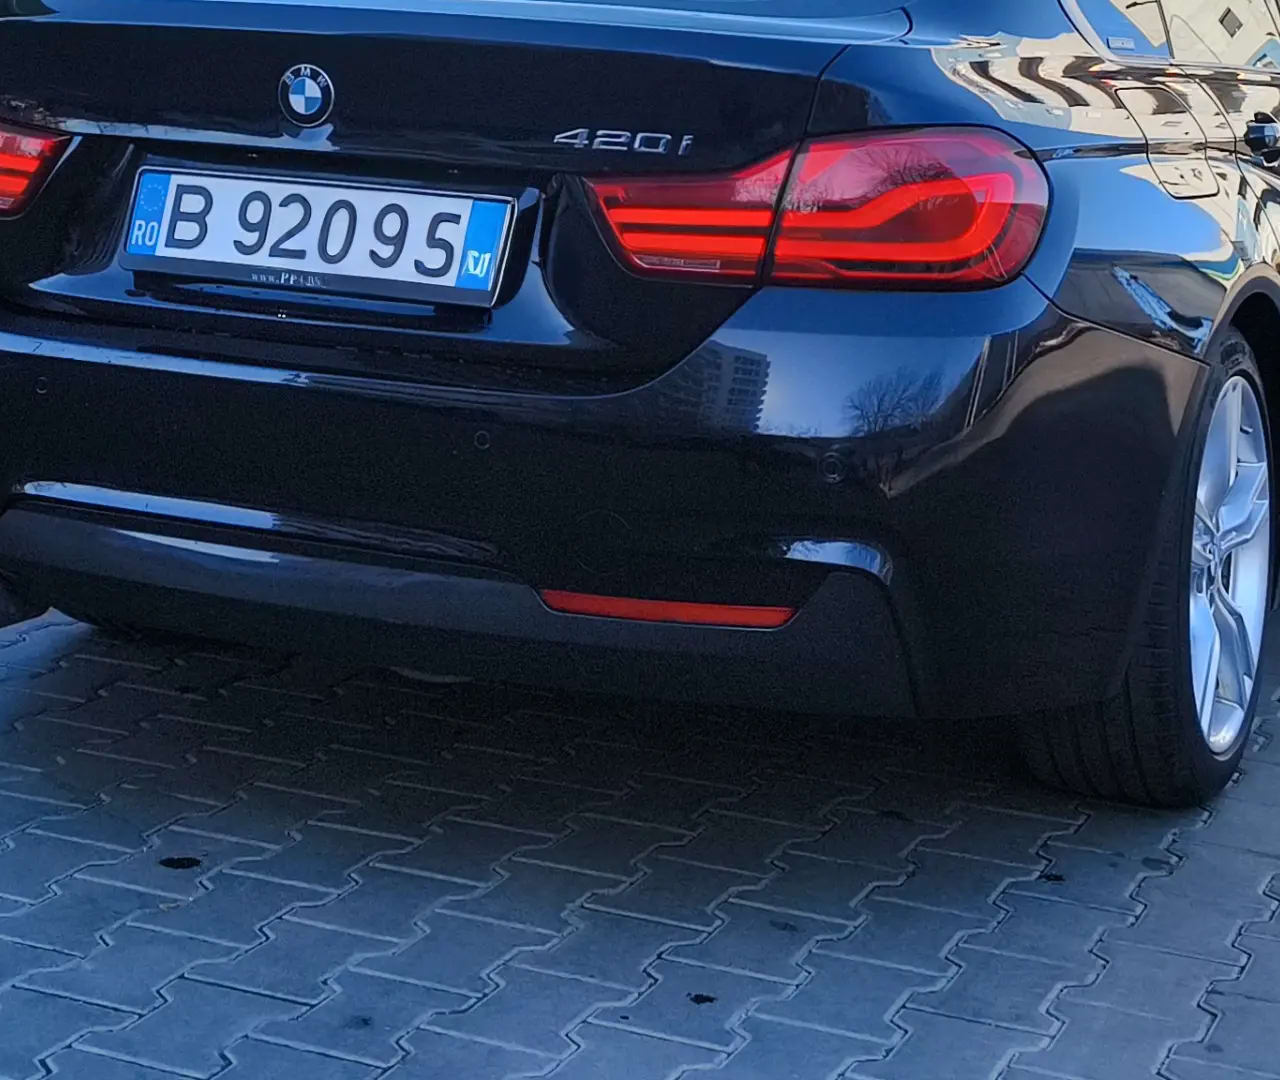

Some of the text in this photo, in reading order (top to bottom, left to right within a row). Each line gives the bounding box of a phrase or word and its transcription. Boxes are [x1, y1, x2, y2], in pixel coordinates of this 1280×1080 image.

[284, 66, 328, 88] BMW
[131, 219, 159, 247] RO
[164, 183, 462, 279] B 92095
